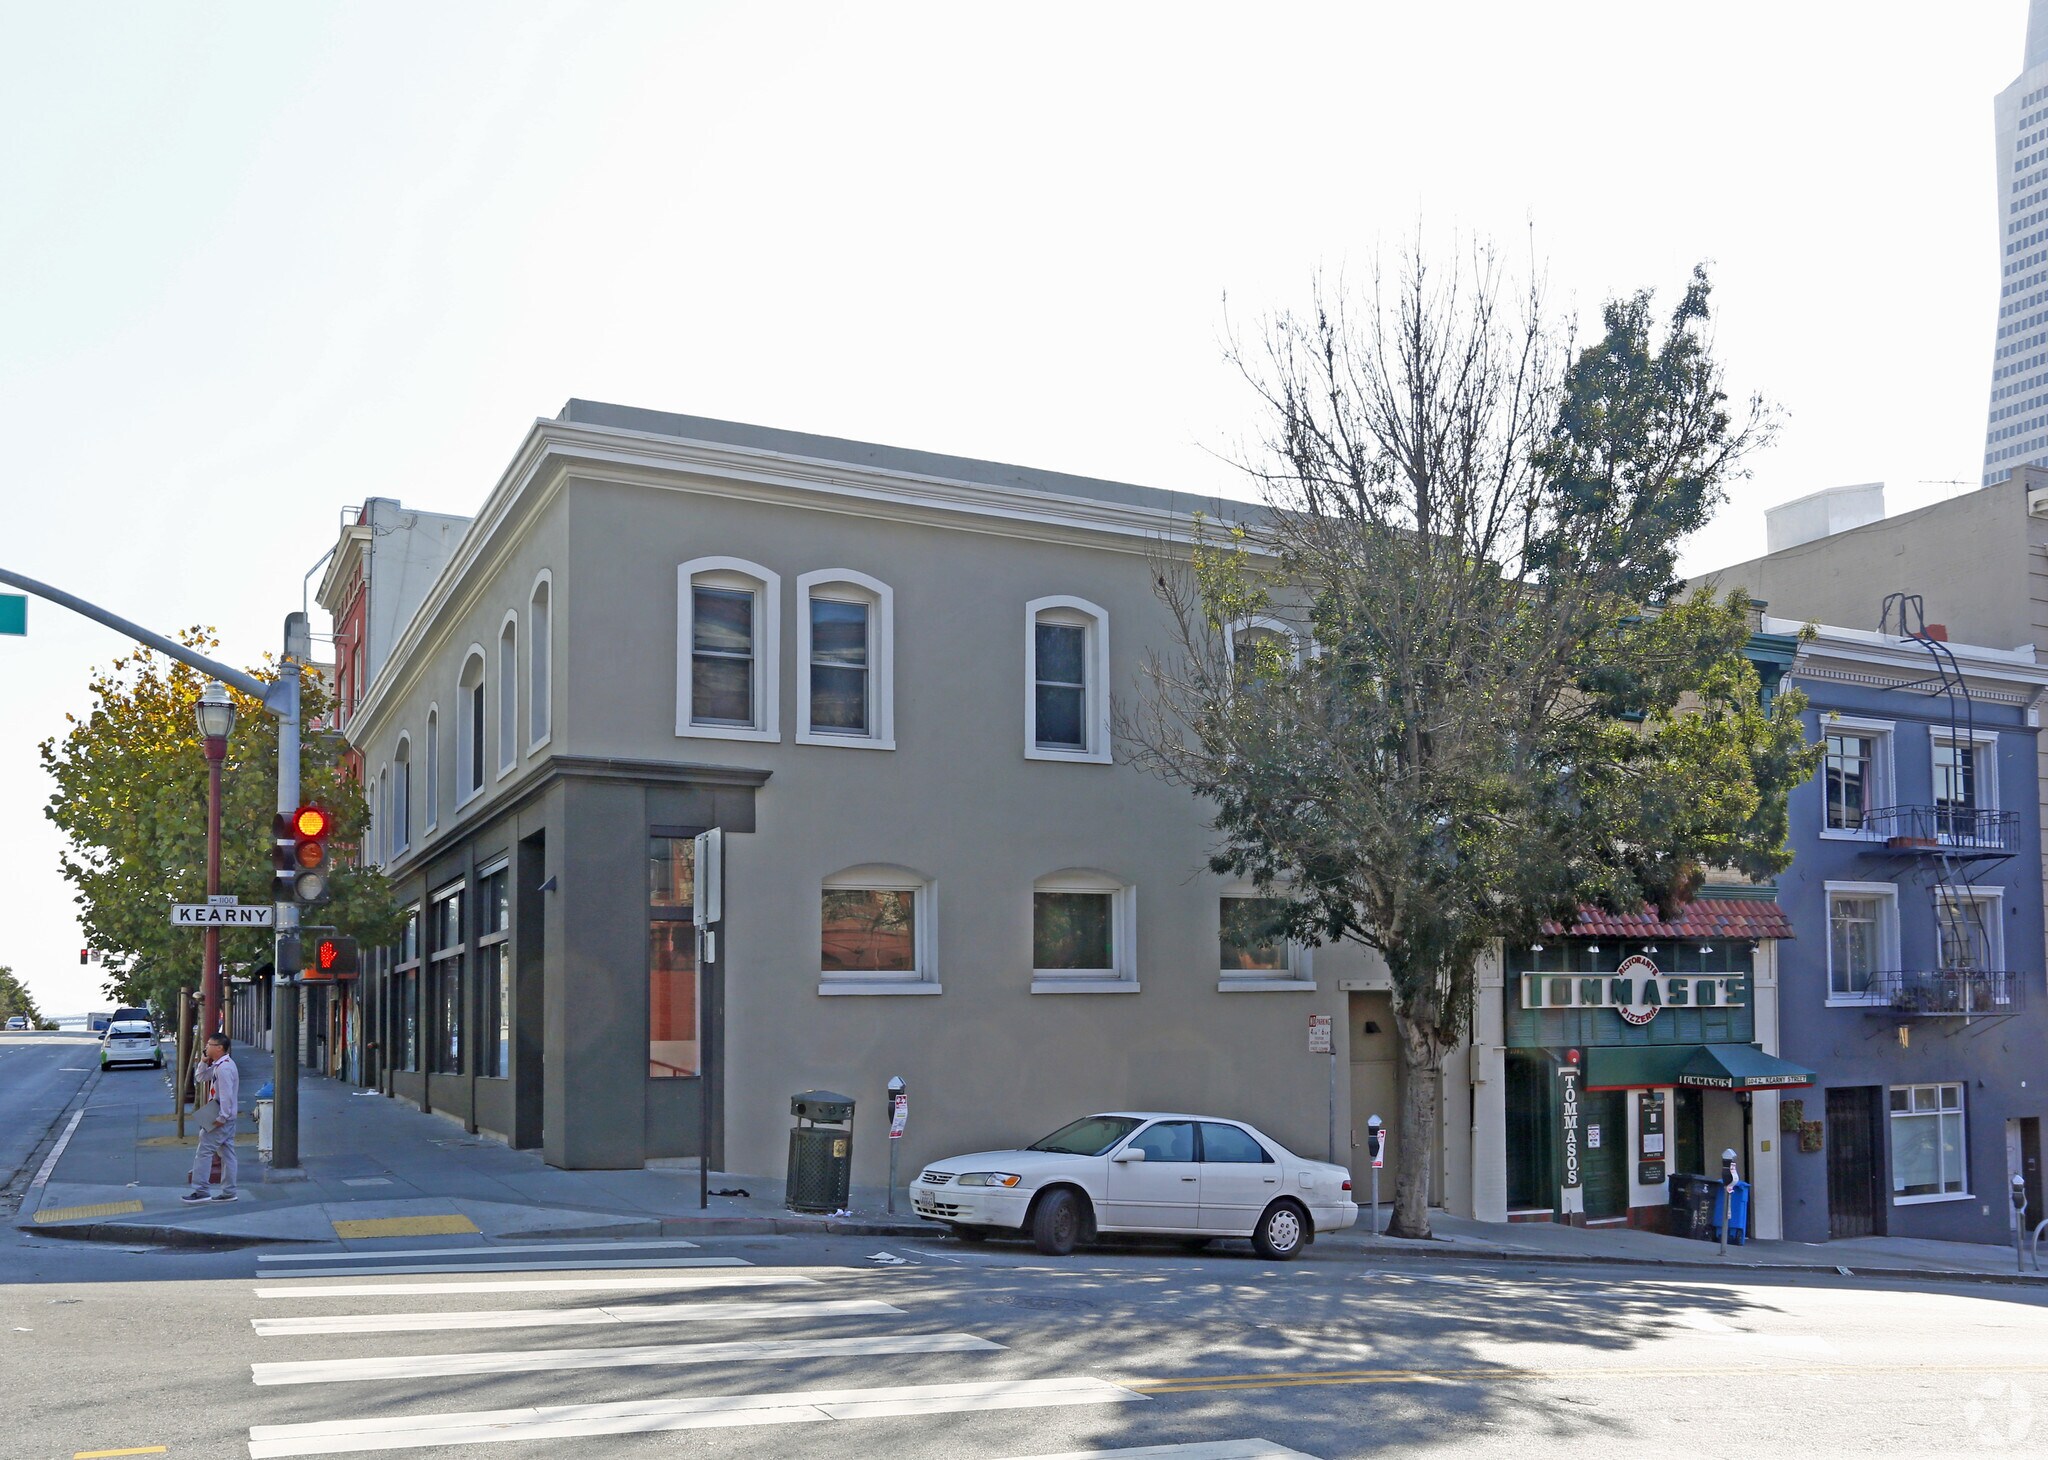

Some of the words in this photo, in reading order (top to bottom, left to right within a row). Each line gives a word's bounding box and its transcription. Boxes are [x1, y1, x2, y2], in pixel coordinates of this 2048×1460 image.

[219, 896, 234, 904] 1100
[180, 908, 267, 922] KEARNY
[1618, 956, 1659, 976] RISTORANTE
[1530, 974, 1746, 1007] TOMMASO'S
[1621, 1006, 1658, 1023] PIZZERIA
[1765, 1076, 1786, 1084] KEARNY
[1564, 1075, 1580, 1185] TOMMASO'S
